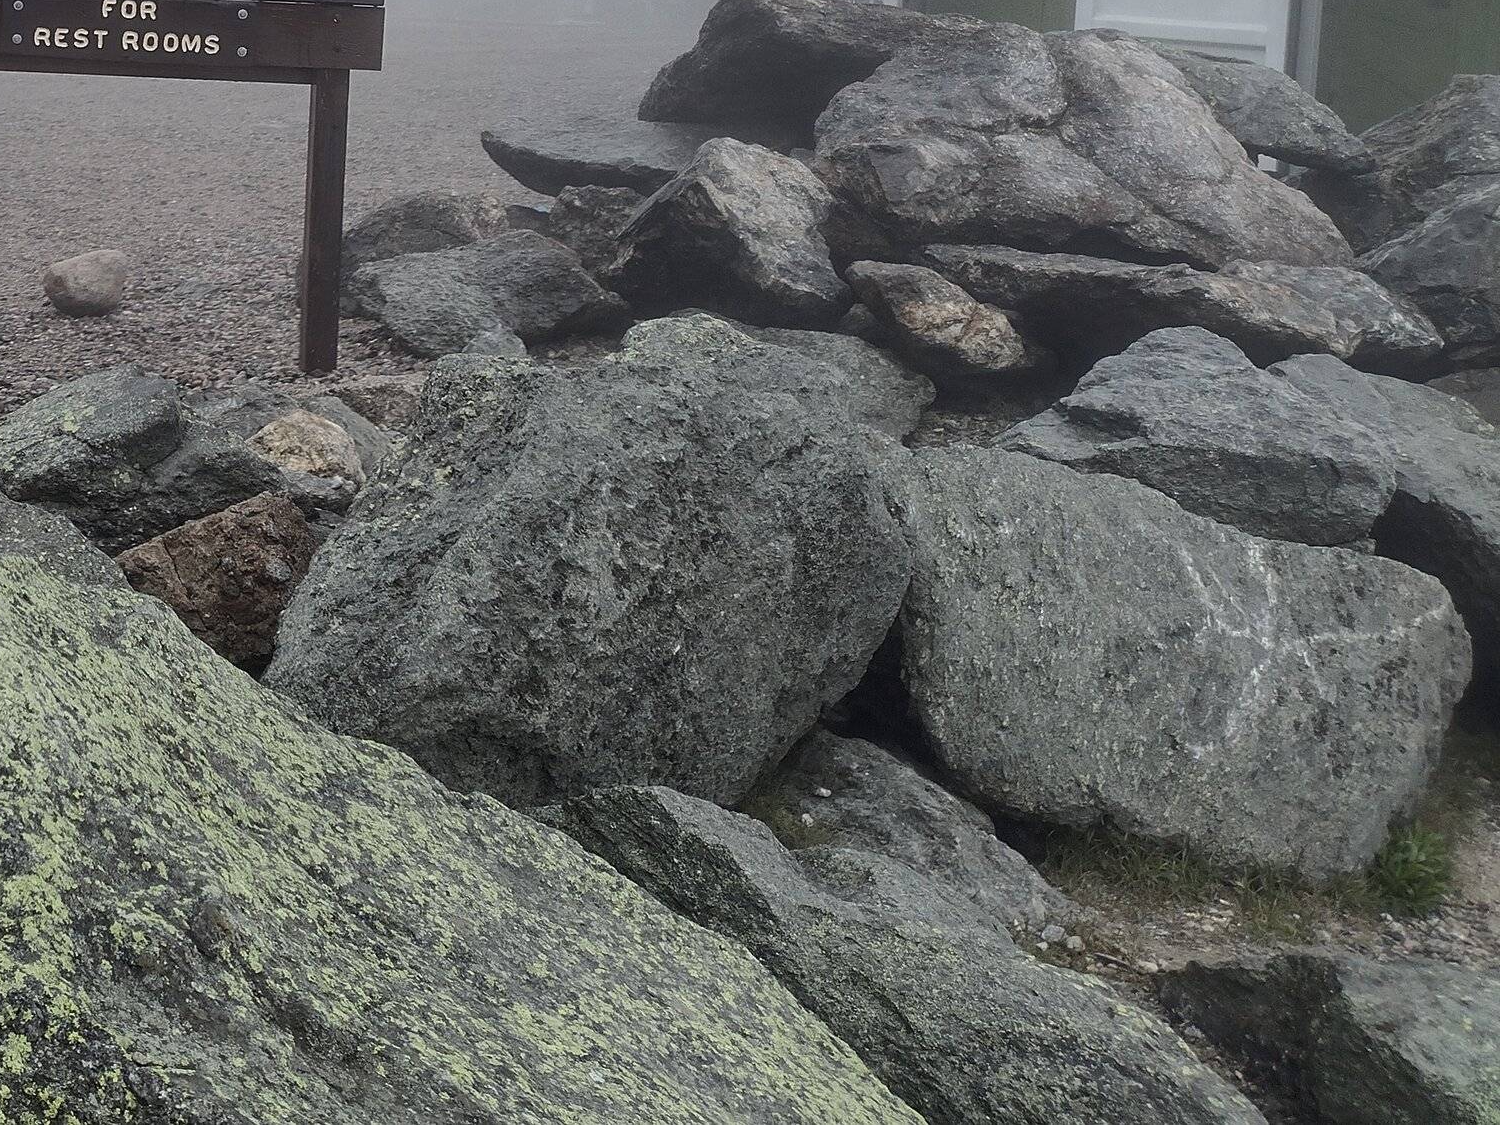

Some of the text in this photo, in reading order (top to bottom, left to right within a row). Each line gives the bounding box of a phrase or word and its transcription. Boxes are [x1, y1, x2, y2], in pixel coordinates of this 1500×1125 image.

[102, 0, 156, 20] FOR
[34, 27, 219, 54] REST ROOMS
